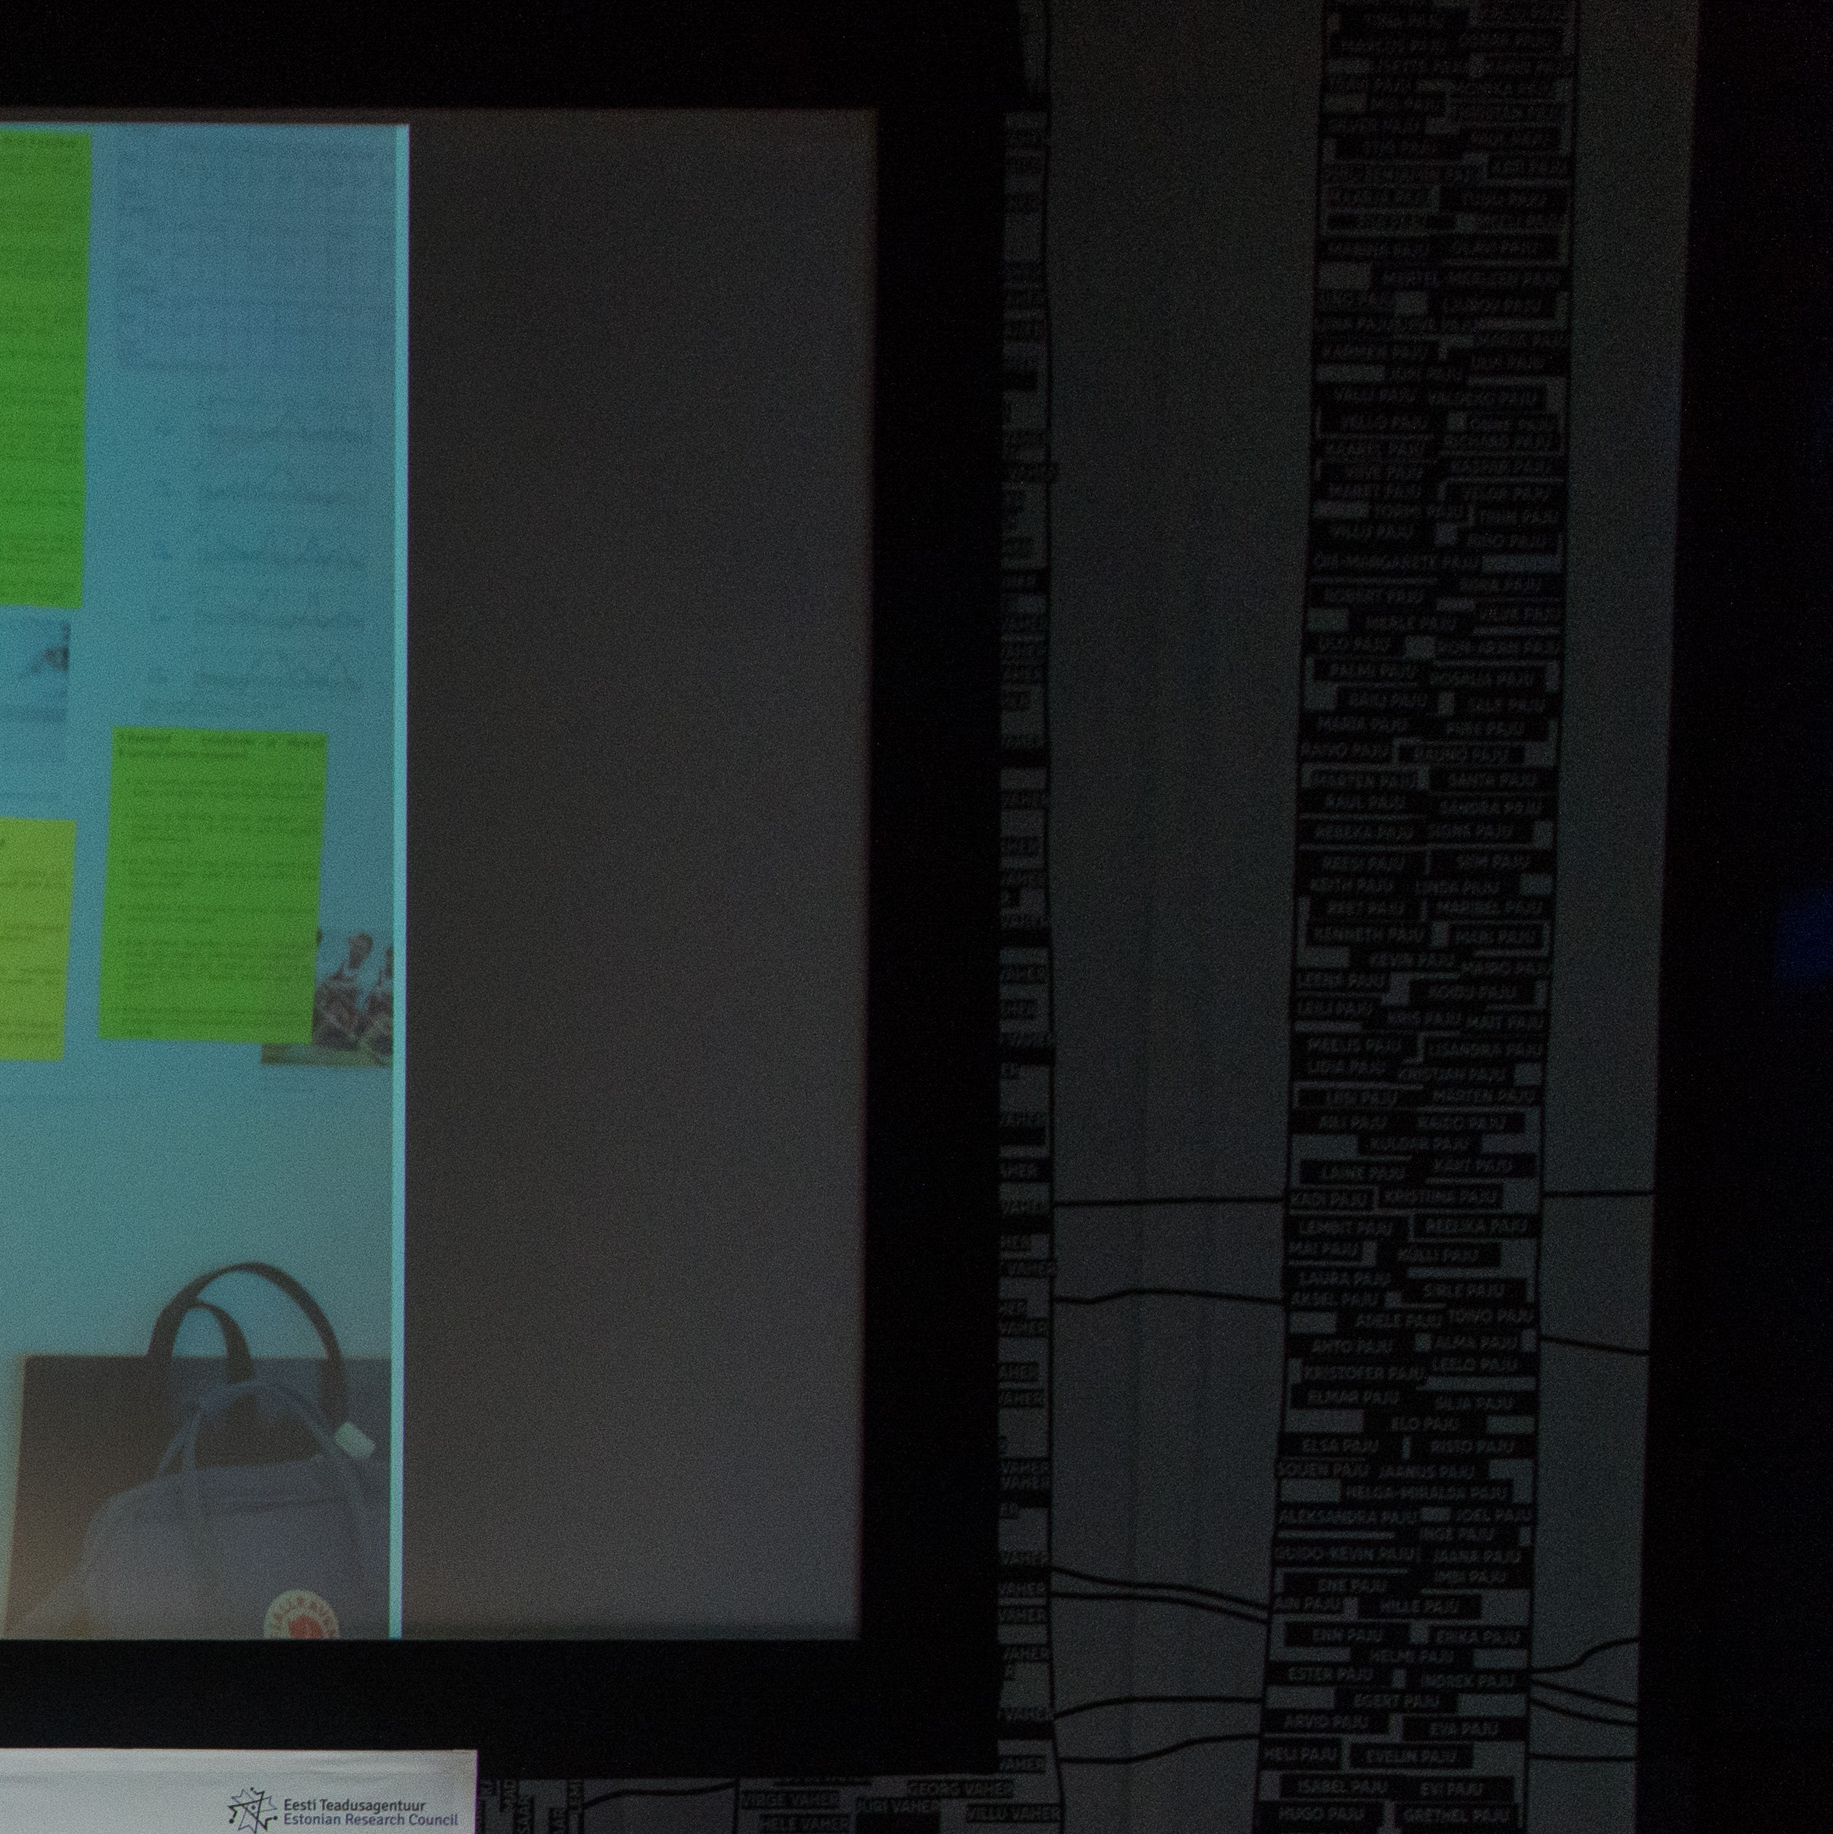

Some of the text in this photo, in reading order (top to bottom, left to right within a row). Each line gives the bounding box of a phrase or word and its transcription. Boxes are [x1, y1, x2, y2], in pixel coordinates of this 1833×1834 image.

[284, 1799, 426, 1814] Eesti Teadusagentuur
[284, 1813, 458, 1826] Estonian Research Council
